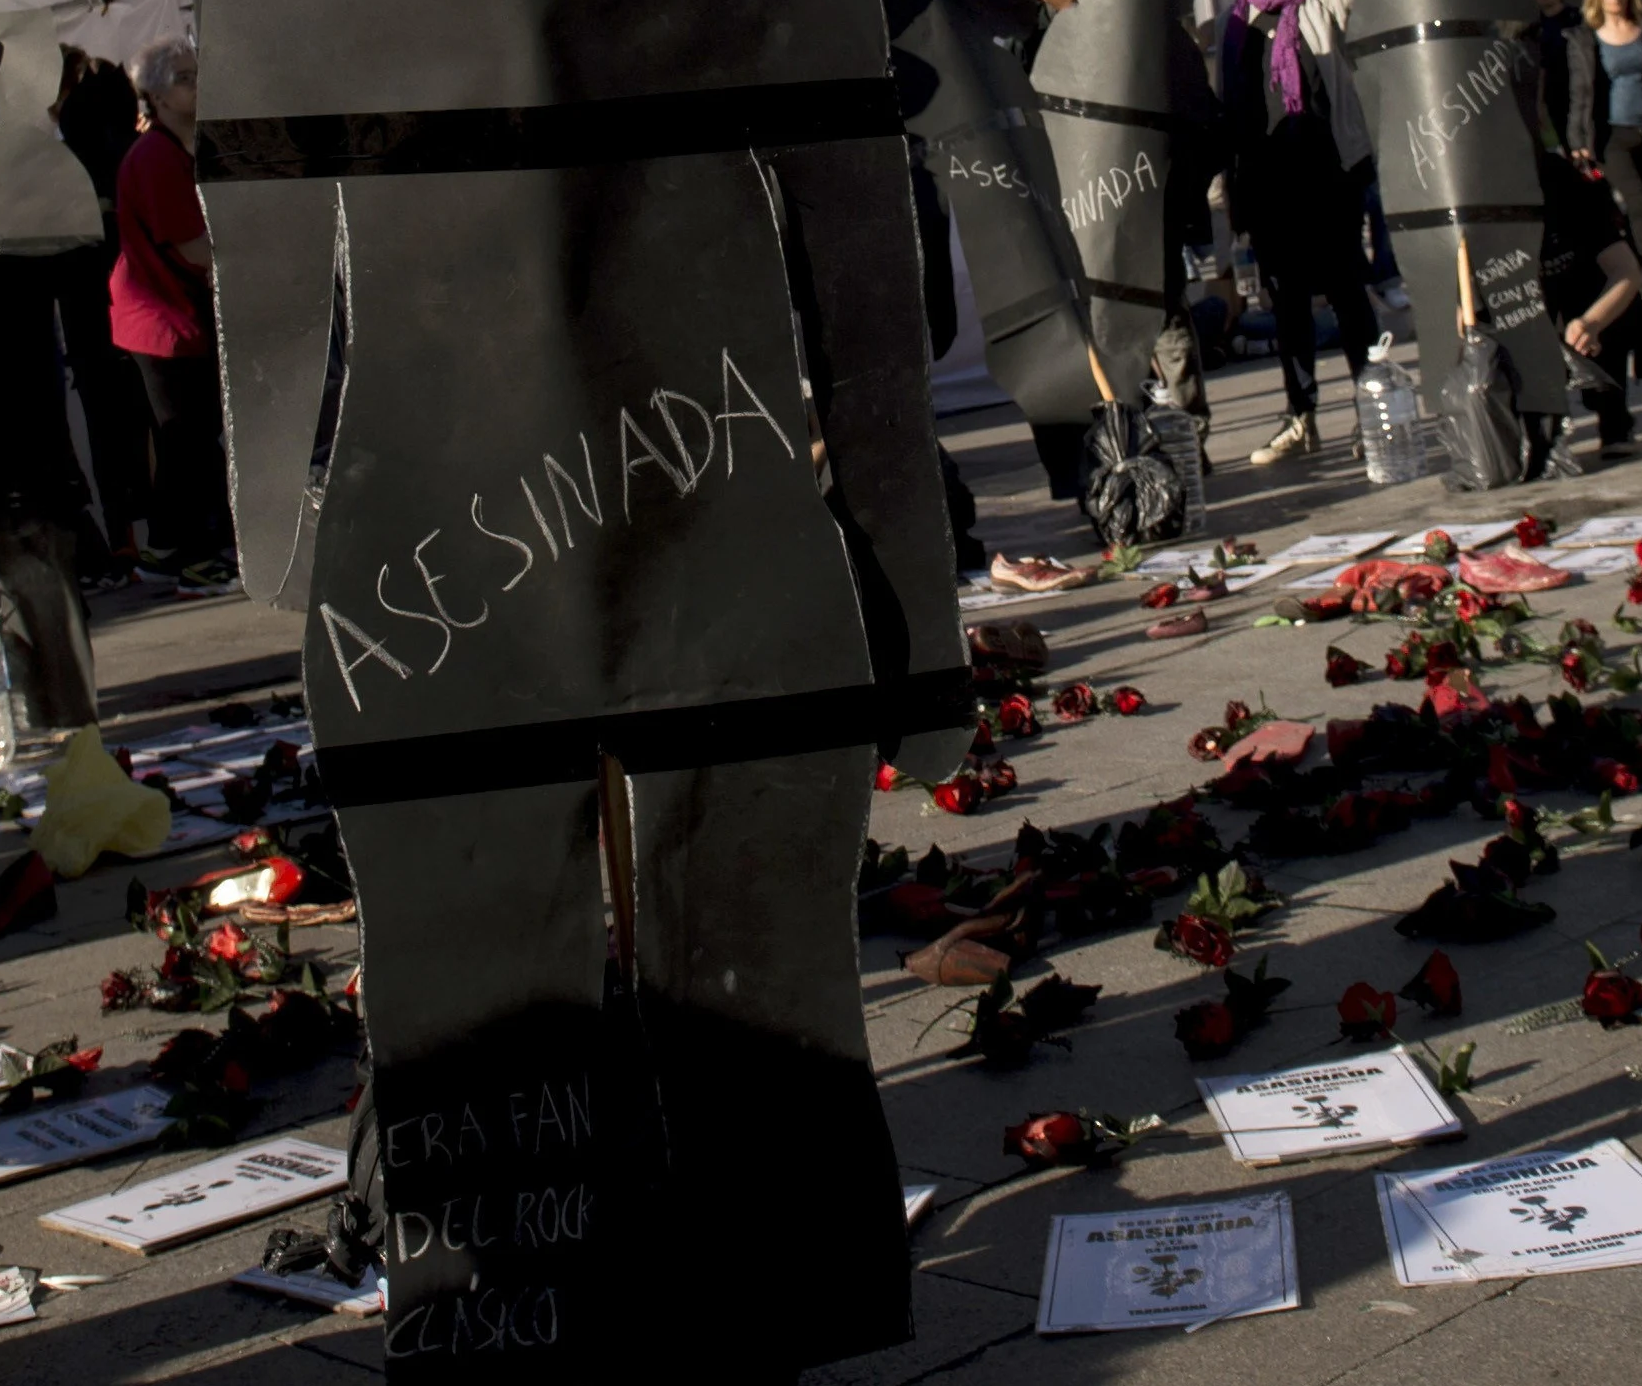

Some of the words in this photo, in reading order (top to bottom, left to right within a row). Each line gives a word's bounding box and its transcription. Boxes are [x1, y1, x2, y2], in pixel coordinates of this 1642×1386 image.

[1406, 37, 1535, 190] ASESINADA
[319, 346, 795, 712] ASESINADA
[386, 1102, 487, 1168] ERA
[508, 1071, 593, 1155] FAN
[1235, 1067, 1384, 1094] ASASINADA
[1433, 1158, 1599, 1192] ASASINADA
[394, 1194, 501, 1264] DEL
[512, 1182, 595, 1249] ROCK
[1086, 1216, 1255, 1243] ASASINADA
